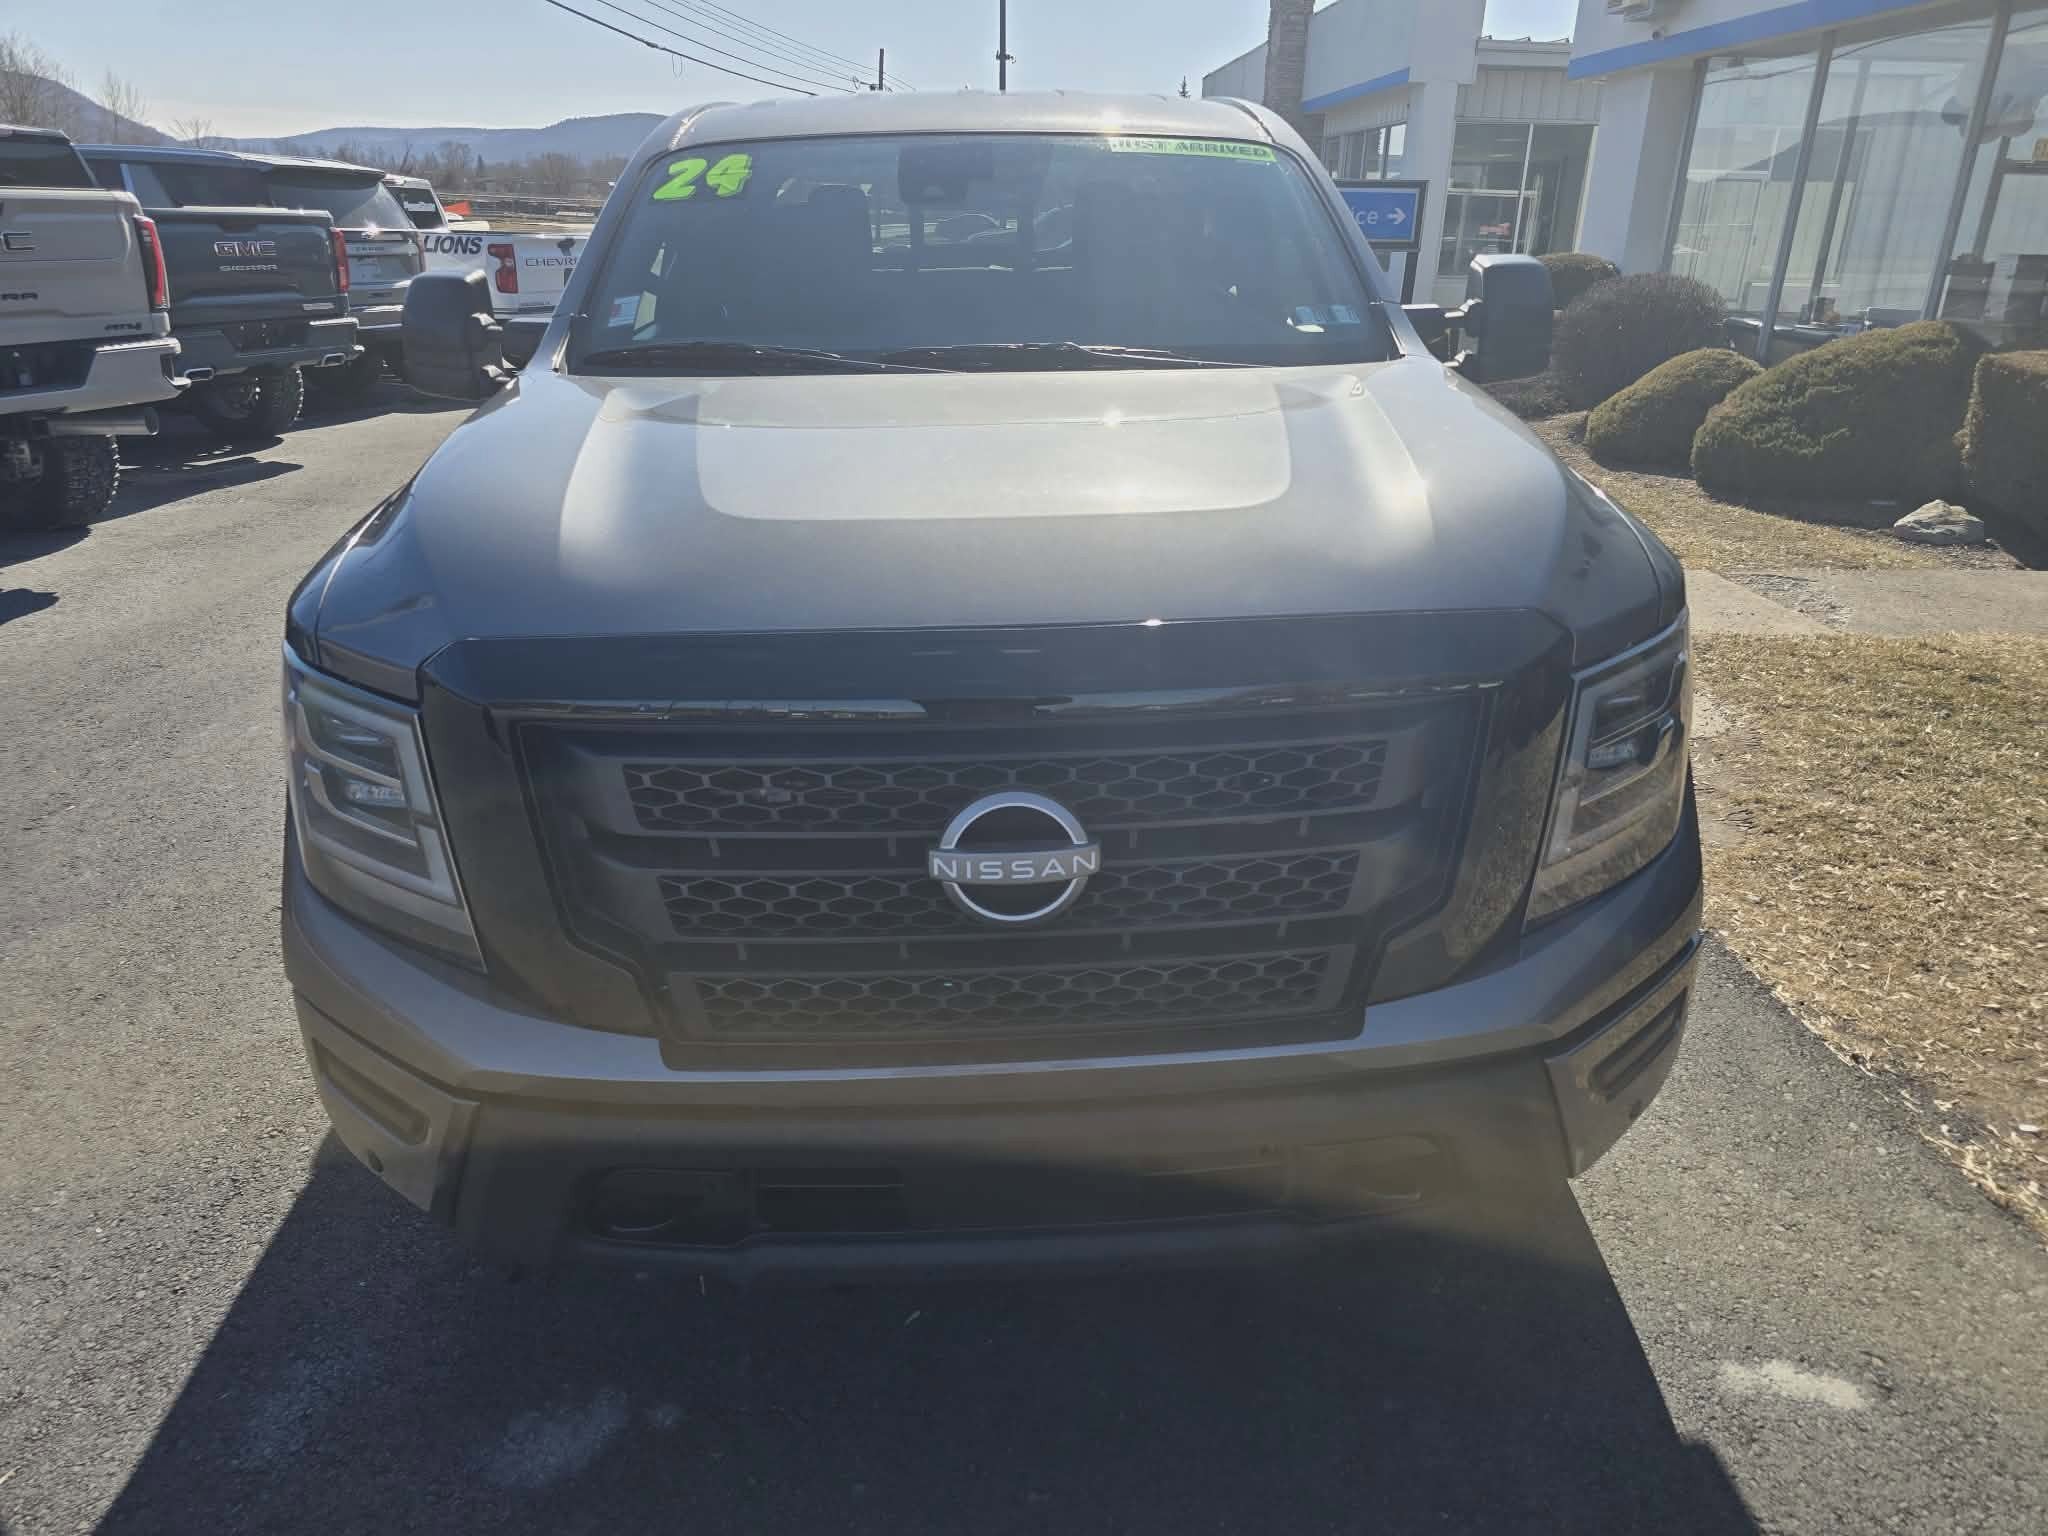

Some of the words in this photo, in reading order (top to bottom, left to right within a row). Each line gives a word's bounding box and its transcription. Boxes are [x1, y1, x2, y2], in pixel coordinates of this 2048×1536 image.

[1174, 141, 1267, 157] ARRIVED
[652, 153, 752, 200] 24
[213, 240, 278, 256] GMC
[424, 234, 482, 255] LIONS
[932, 851, 1097, 880] NISSAN
